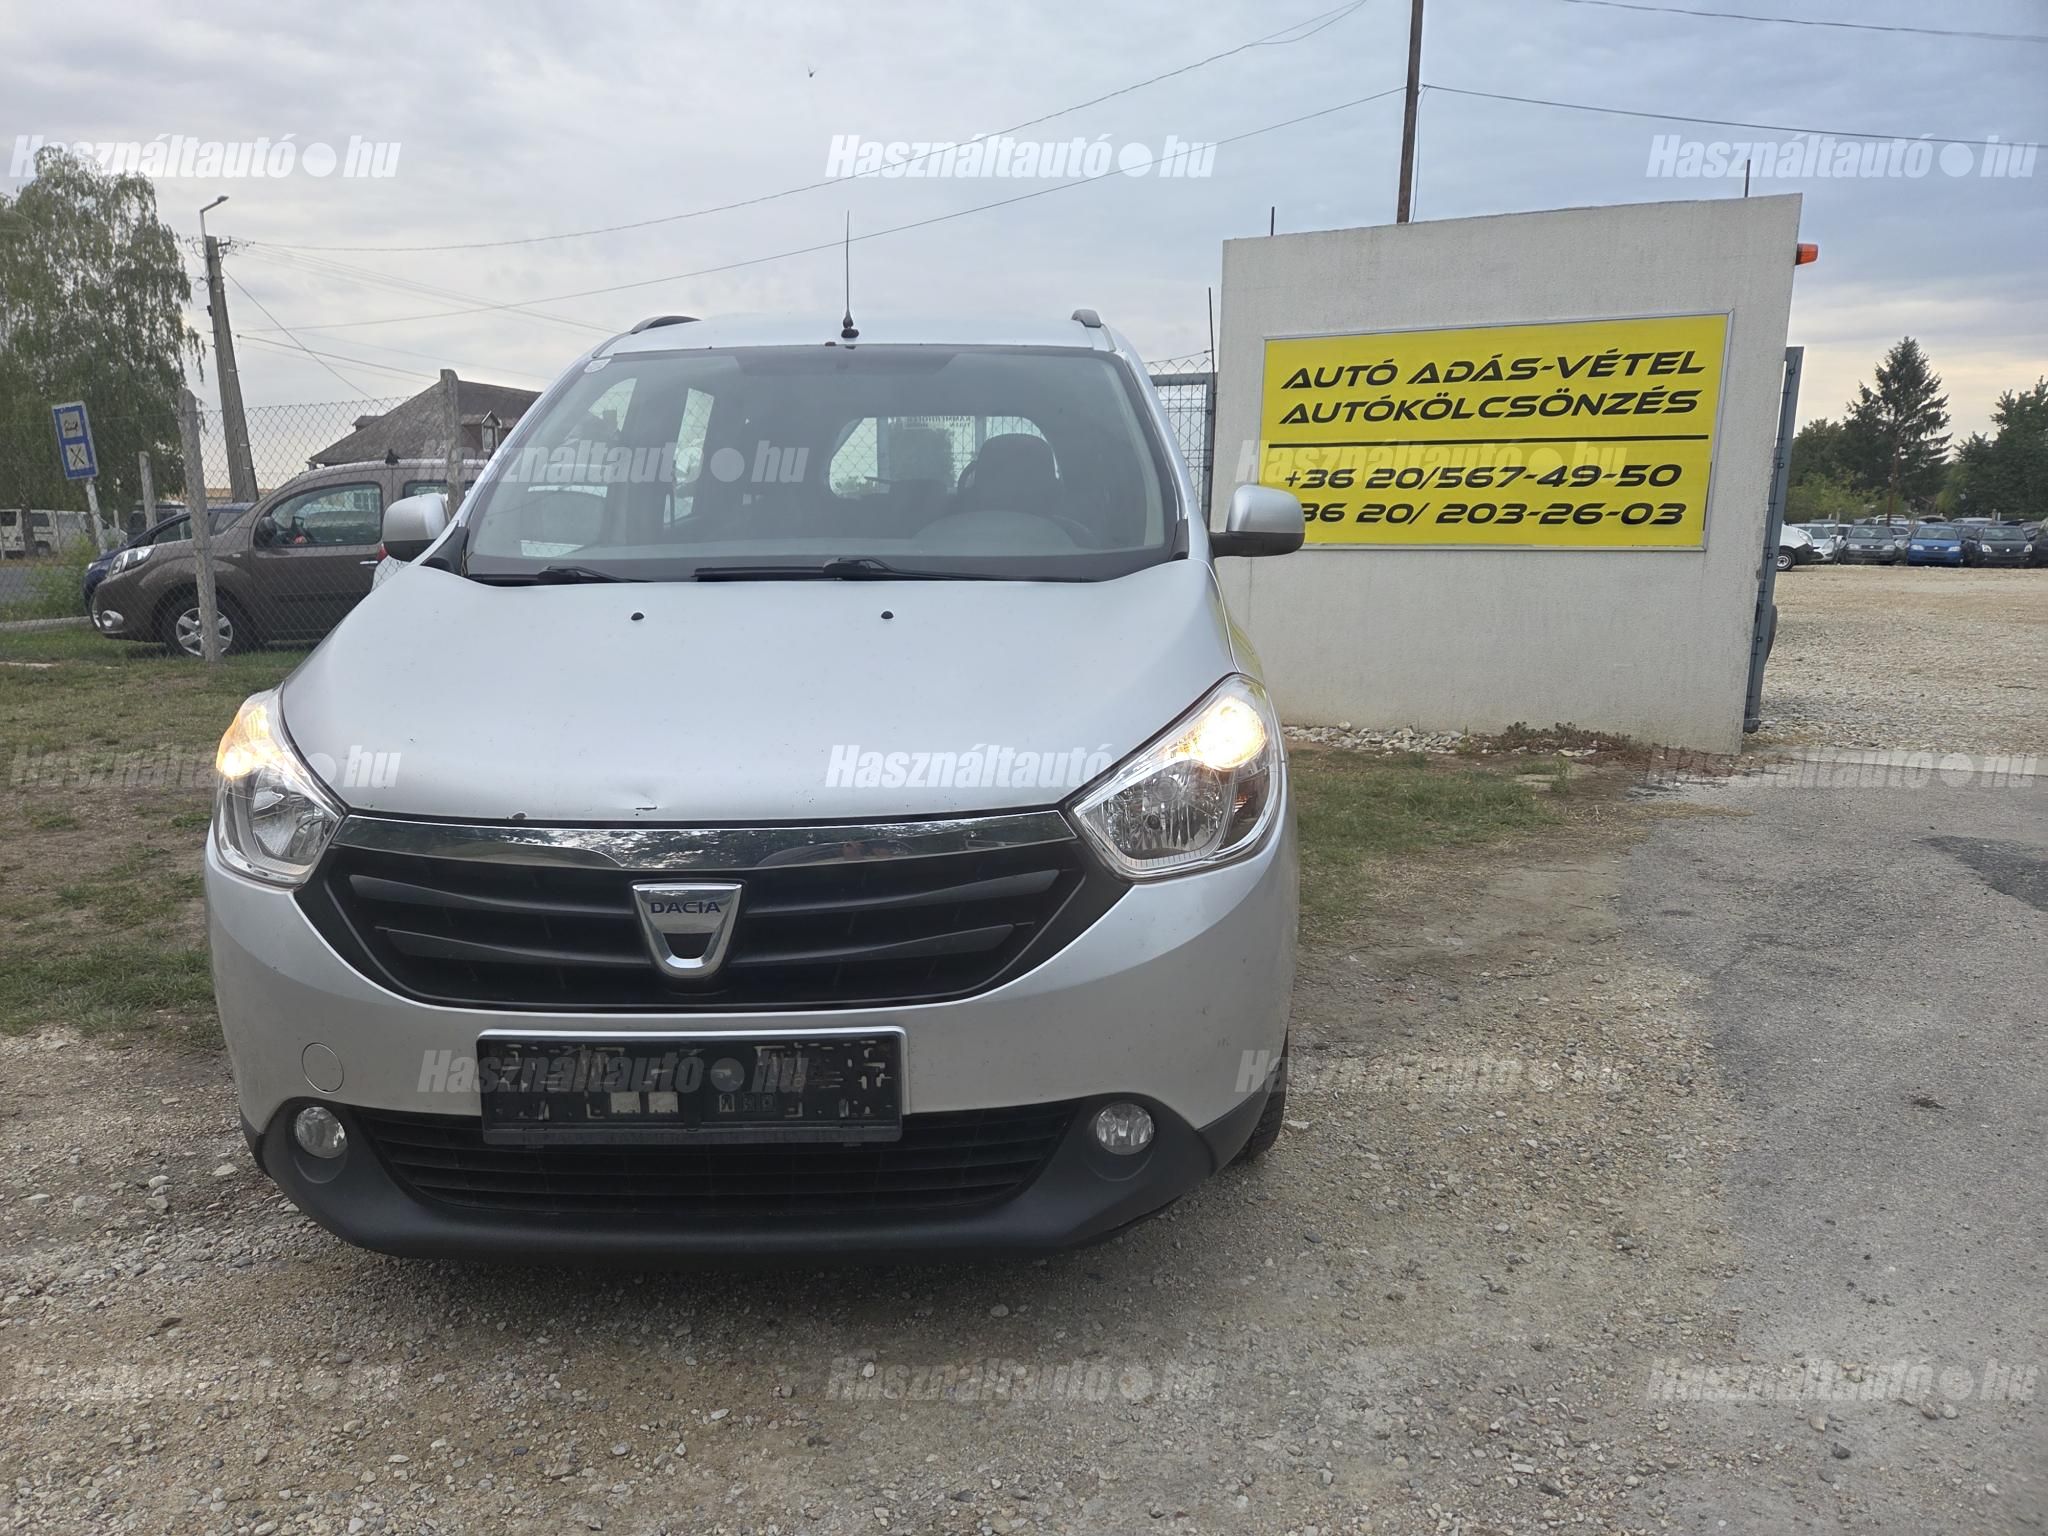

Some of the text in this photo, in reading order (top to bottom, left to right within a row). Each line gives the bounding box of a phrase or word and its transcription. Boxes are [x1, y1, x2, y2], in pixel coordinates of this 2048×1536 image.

[1281, 348, 1706, 389] AUTÓ ADÁS-VÉTEL
[1279, 385, 1703, 424] AUTÓKÖLCSÖNZÉS
[1285, 464, 1682, 490] +36 20/567-49-50
[1435, 502, 1687, 525] 203-26-03
[650, 901, 721, 914] DACIA
